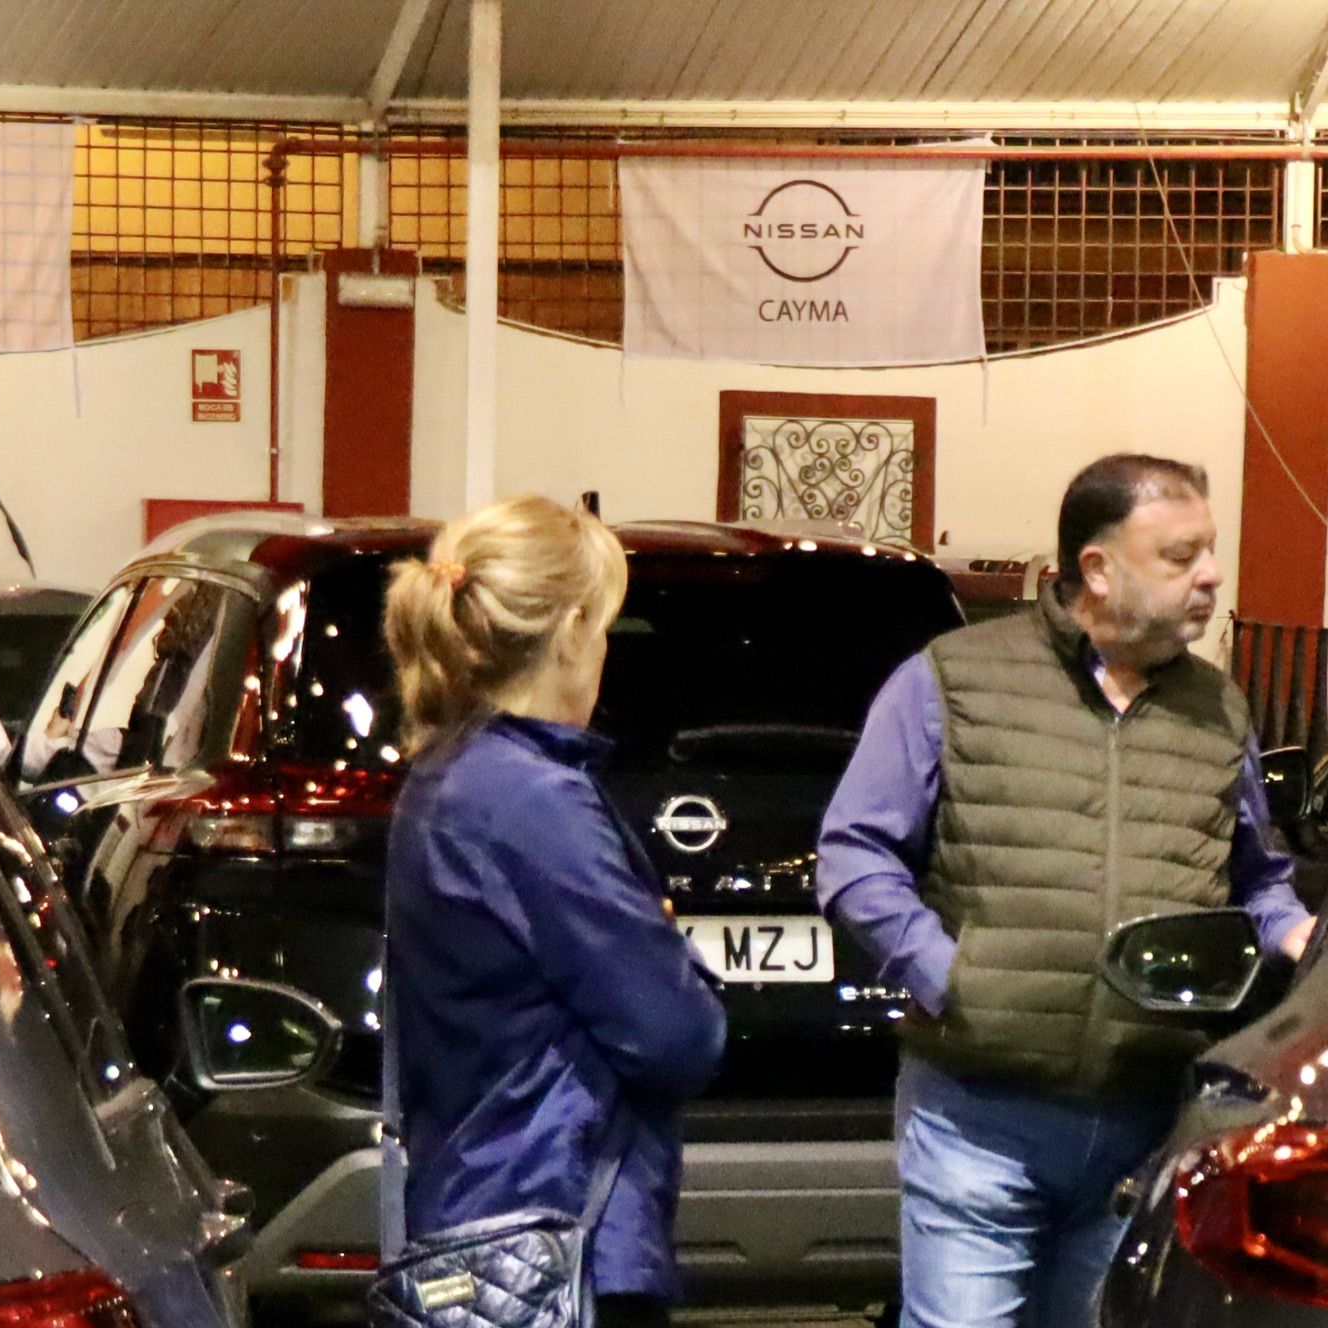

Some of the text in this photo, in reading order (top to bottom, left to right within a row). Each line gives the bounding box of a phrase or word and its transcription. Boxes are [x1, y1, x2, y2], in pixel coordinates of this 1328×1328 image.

[743, 223, 865, 240] NISSAN
[758, 299, 849, 322] CAYMA
[657, 819, 727, 831] NISSAN
[722, 926, 820, 972] MZJ
